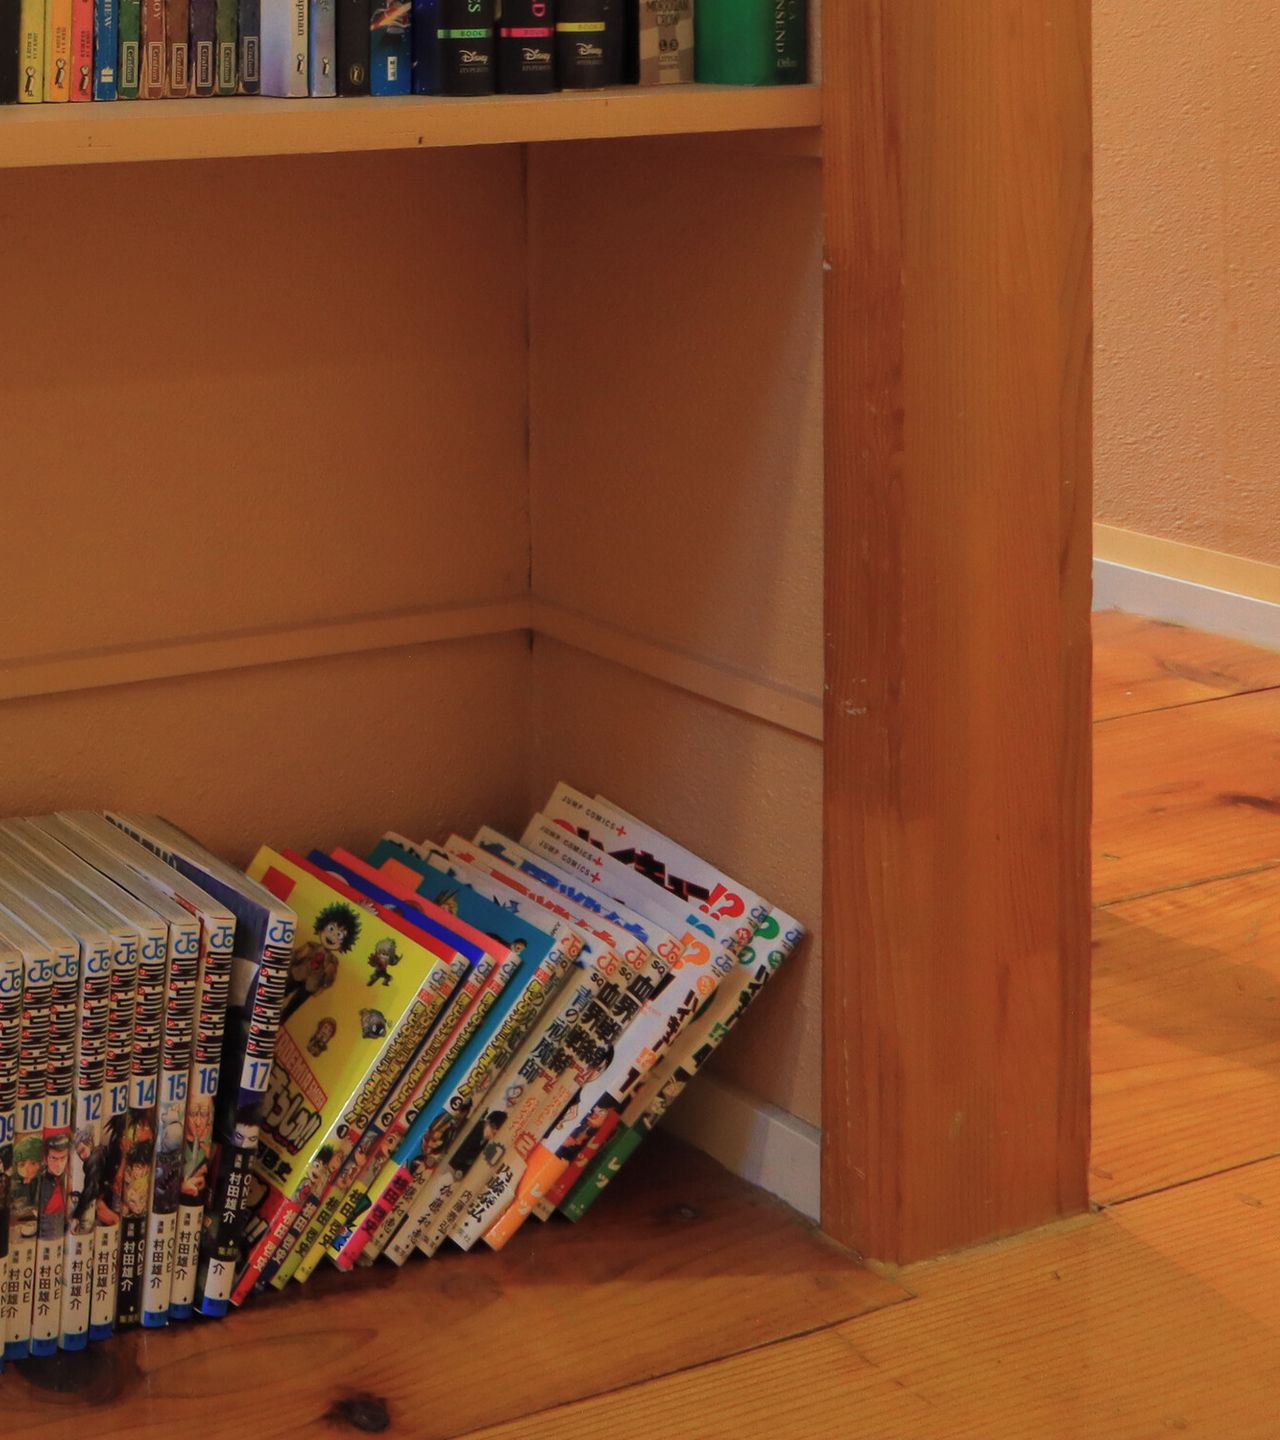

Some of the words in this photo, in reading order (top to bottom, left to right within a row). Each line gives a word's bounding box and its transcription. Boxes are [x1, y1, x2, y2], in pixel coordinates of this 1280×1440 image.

[167, 1072, 187, 1101] 15
[200, 1066, 219, 1095] 16
[246, 1060, 269, 1090] 17
[83, 1091, 103, 1121] 12
[109, 1085, 129, 1114] 13
[136, 1078, 156, 1108] 14
[22, 1102, 42, 1131] 10
[50, 1097, 70, 1128] 11
[221, 1171, 240, 1223] 村田雄介
